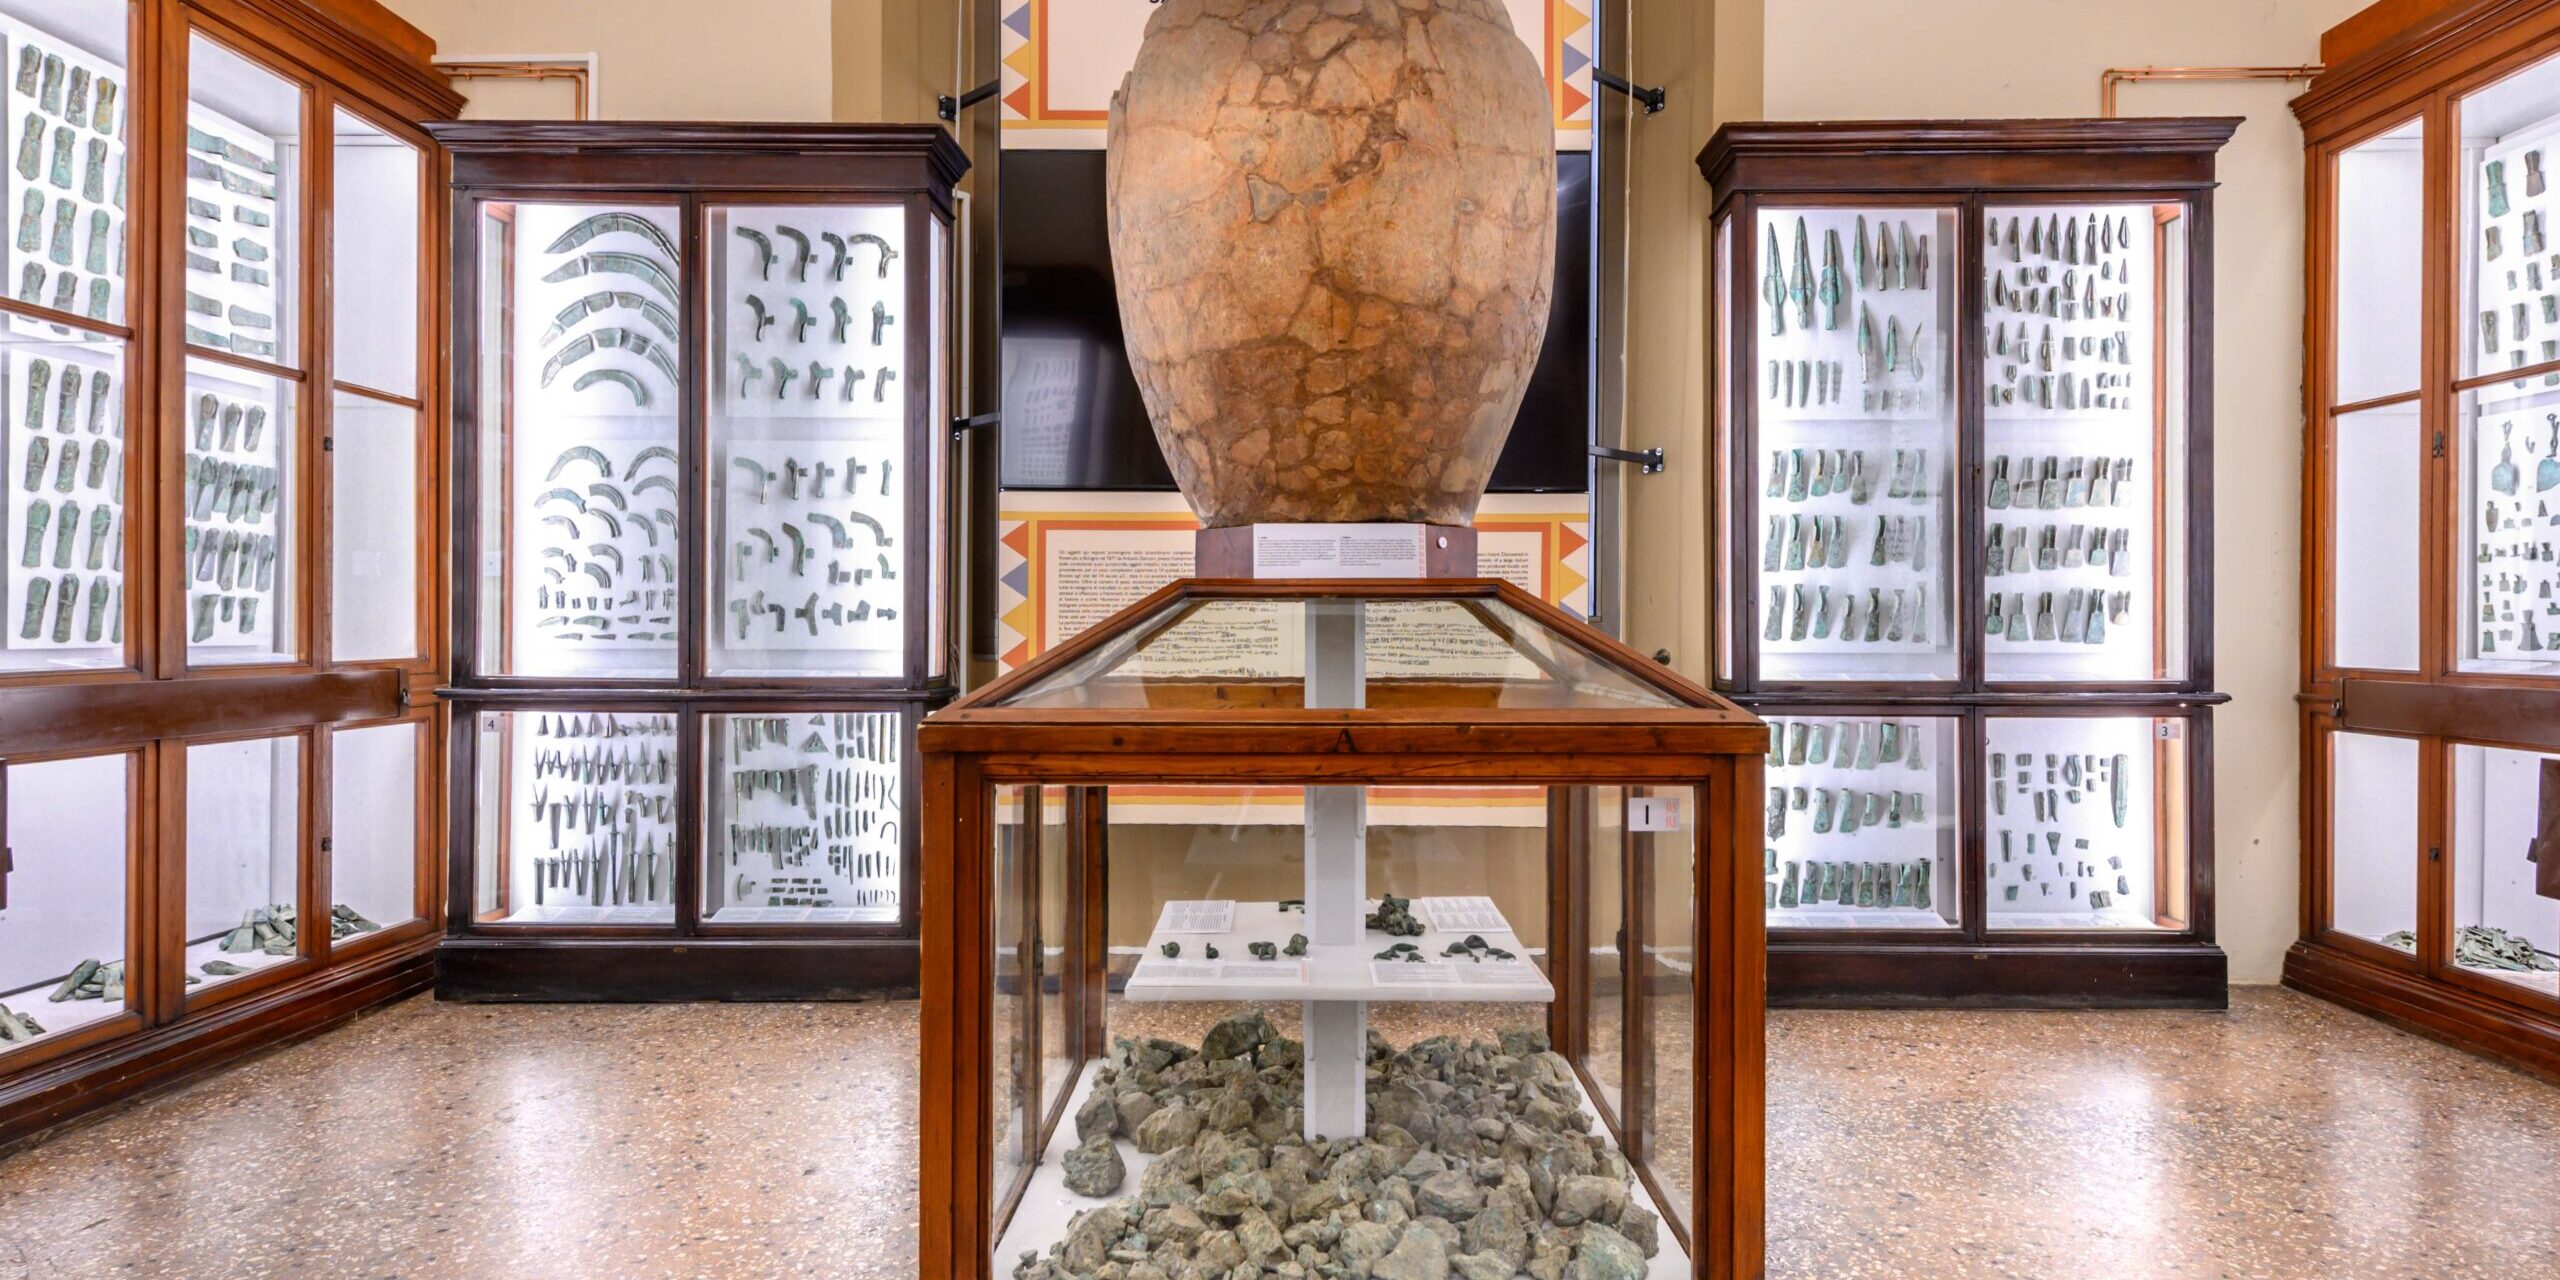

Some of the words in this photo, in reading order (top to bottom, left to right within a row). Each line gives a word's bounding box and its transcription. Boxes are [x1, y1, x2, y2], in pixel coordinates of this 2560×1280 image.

[488, 720, 494, 730] 4
[2162, 727, 2168, 737] 3
[1329, 728, 1358, 753] A
